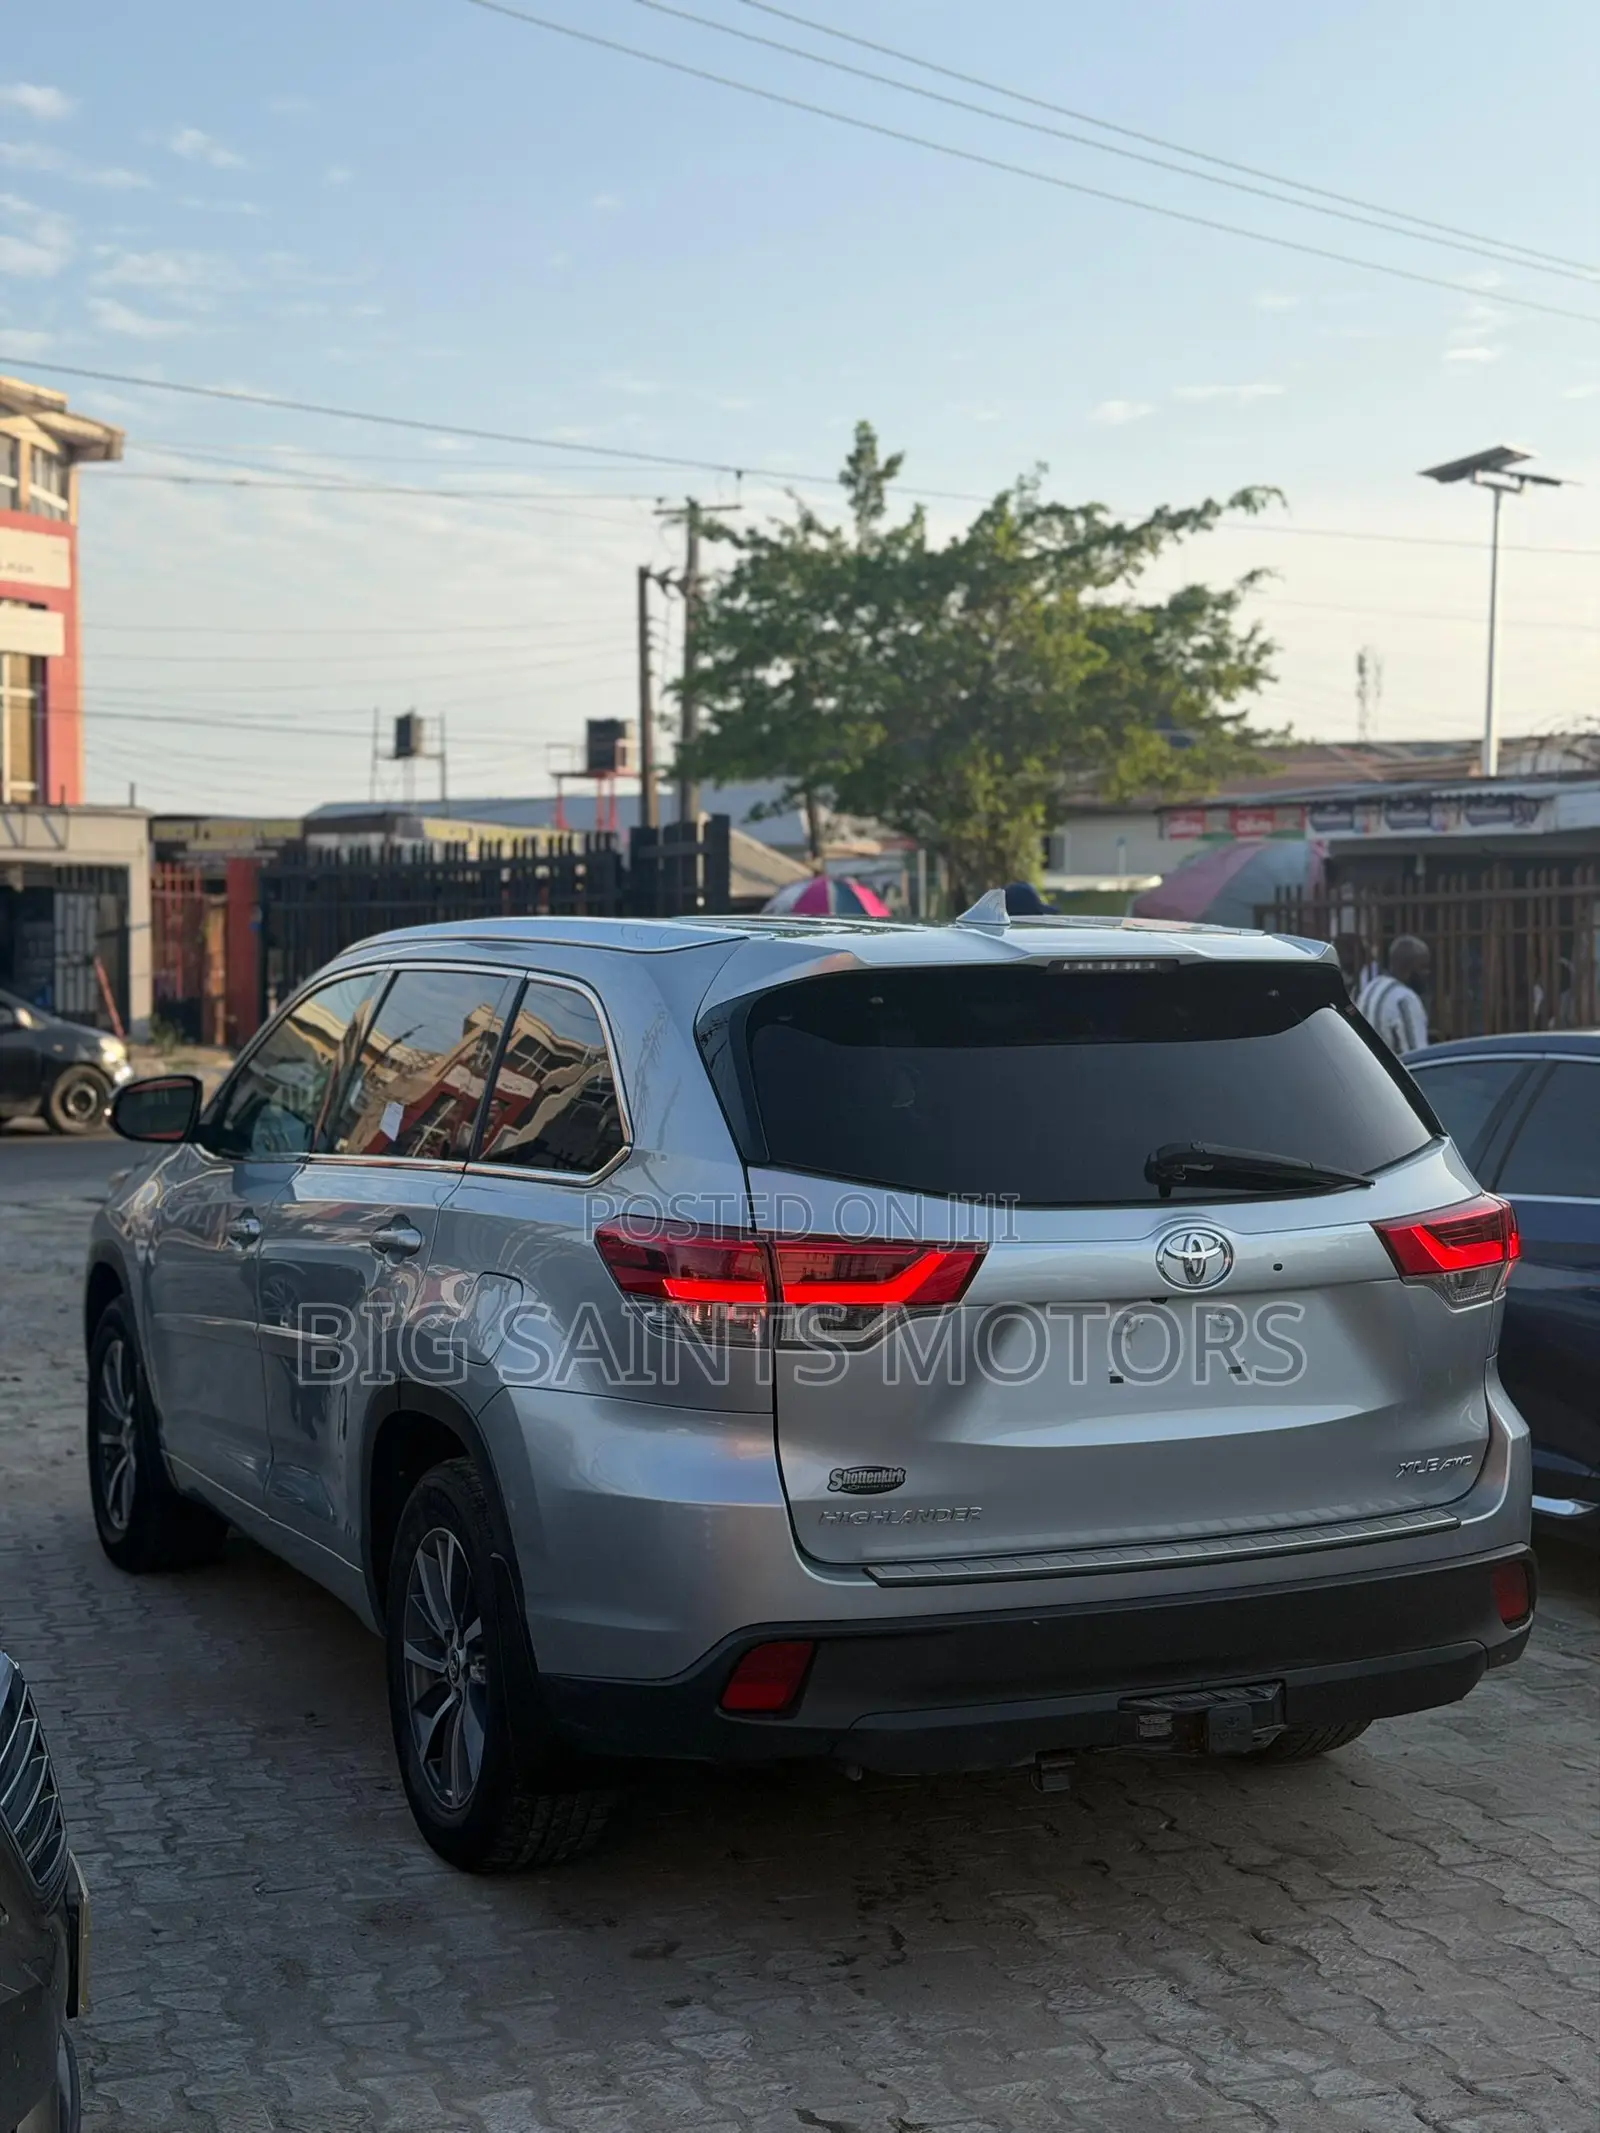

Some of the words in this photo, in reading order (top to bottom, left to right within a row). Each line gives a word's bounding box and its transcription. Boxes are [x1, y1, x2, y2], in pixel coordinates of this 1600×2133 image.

[1395, 1457, 1440, 1479] XLE
[828, 1468, 905, 1491] Shottenkirk
[818, 1506, 983, 1526] HIGHLANDER
